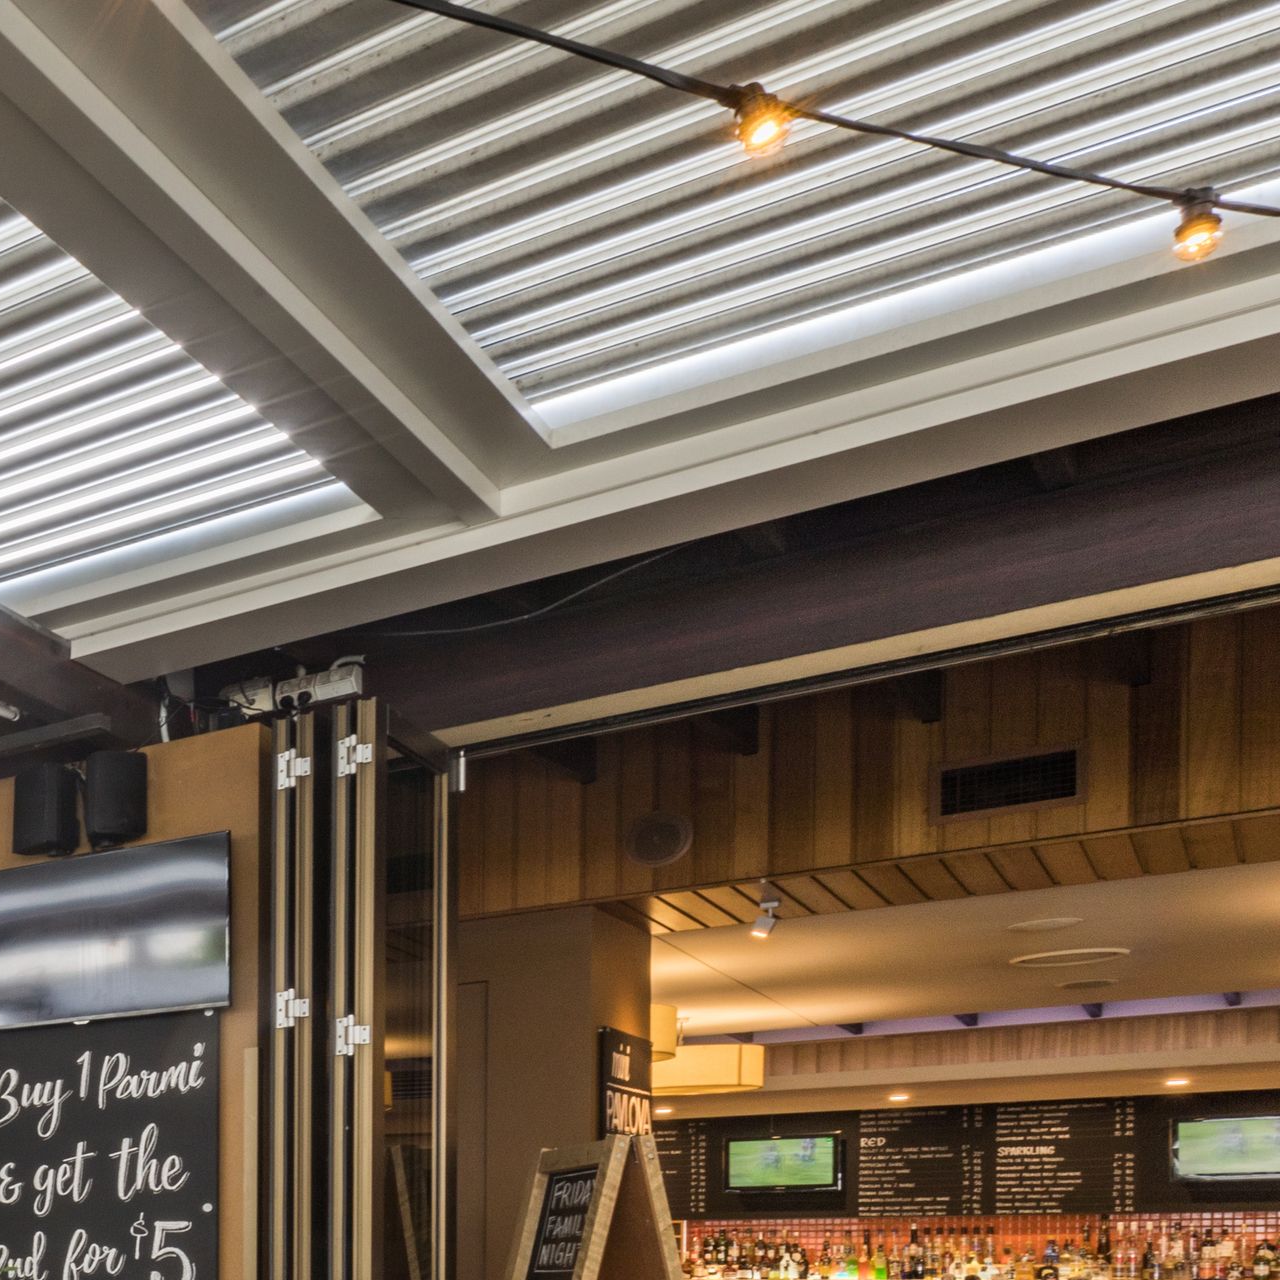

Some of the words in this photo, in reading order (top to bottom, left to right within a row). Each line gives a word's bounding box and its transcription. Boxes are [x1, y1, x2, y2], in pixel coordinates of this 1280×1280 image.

[76, 1050, 92, 1100] 1
[98, 1042, 206, 1110] Parmi
[606, 1090, 652, 1135] PAVLOVA
[860, 1137, 886, 1148] RED
[997, 1146, 1056, 1156] SPARKLING
[33, 1141, 98, 1217] get
[109, 1123, 191, 1202] the
[546, 1214, 582, 1238] FAMIL
